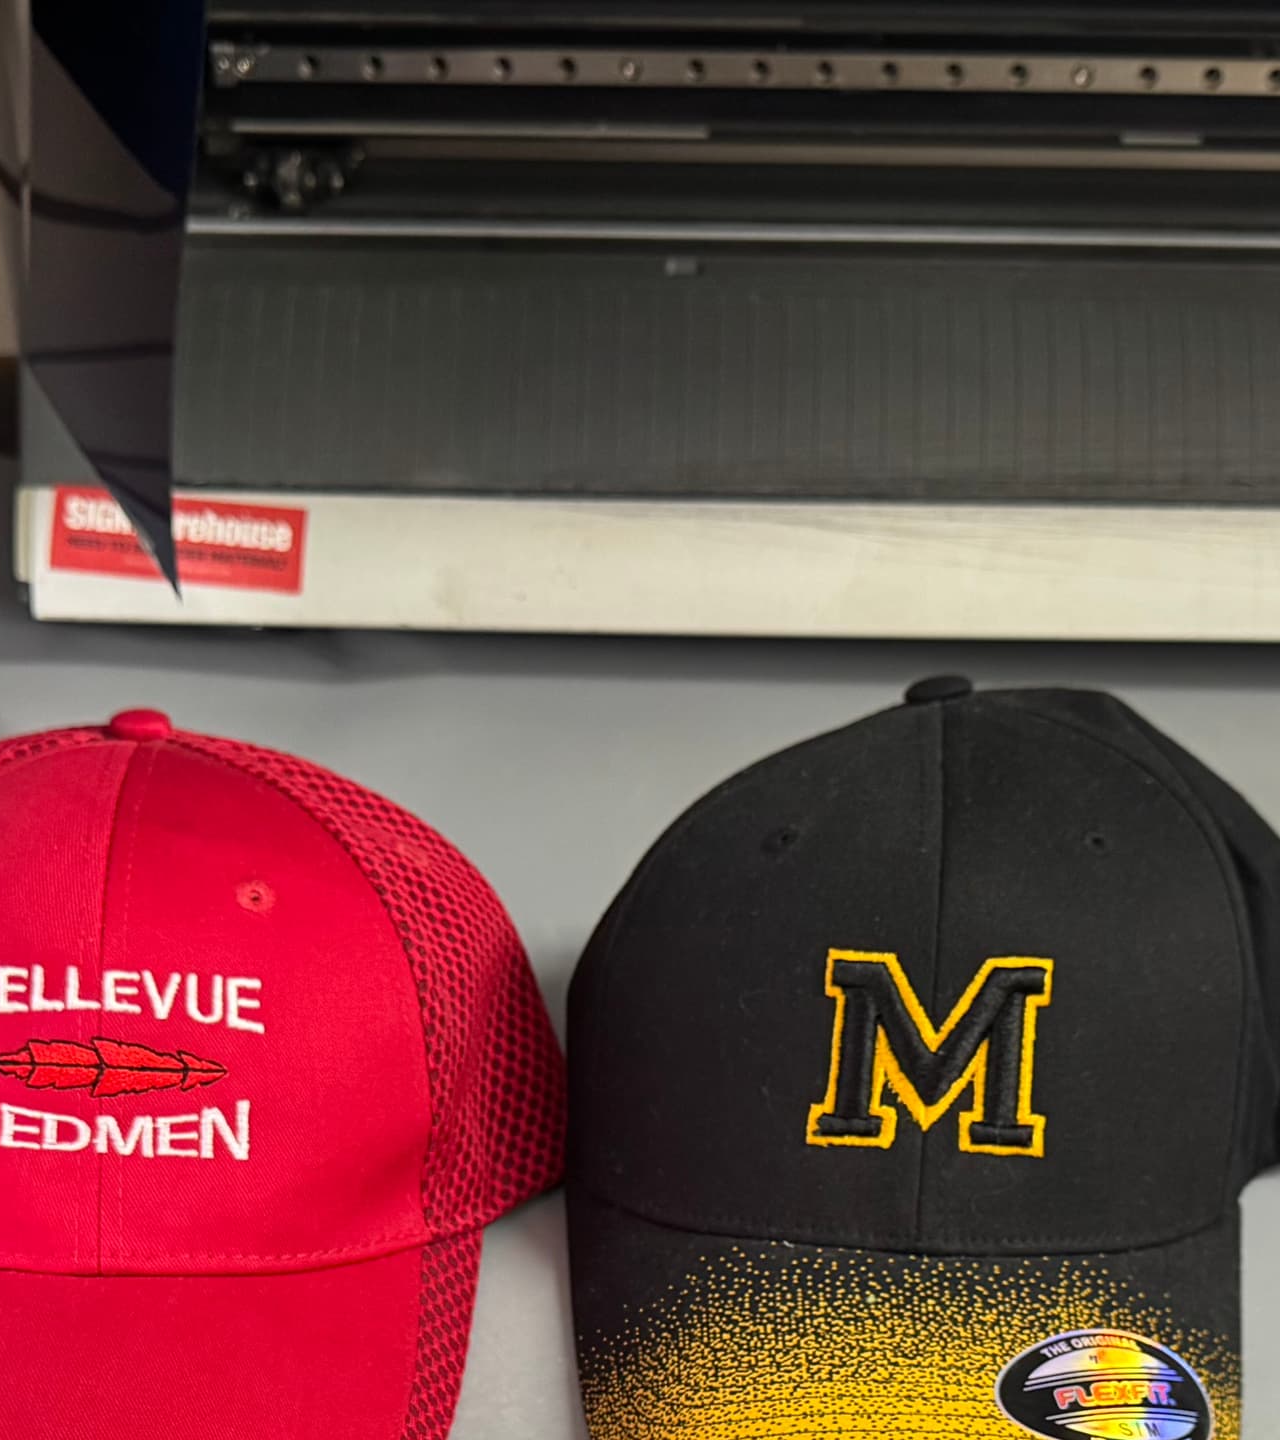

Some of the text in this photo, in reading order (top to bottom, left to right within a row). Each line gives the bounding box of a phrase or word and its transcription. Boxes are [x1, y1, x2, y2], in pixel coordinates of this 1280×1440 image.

[806, 948, 1054, 1157] M
[1040, 1341, 1072, 1358] THE
[1053, 1380, 1172, 1410] FLEXFIT
